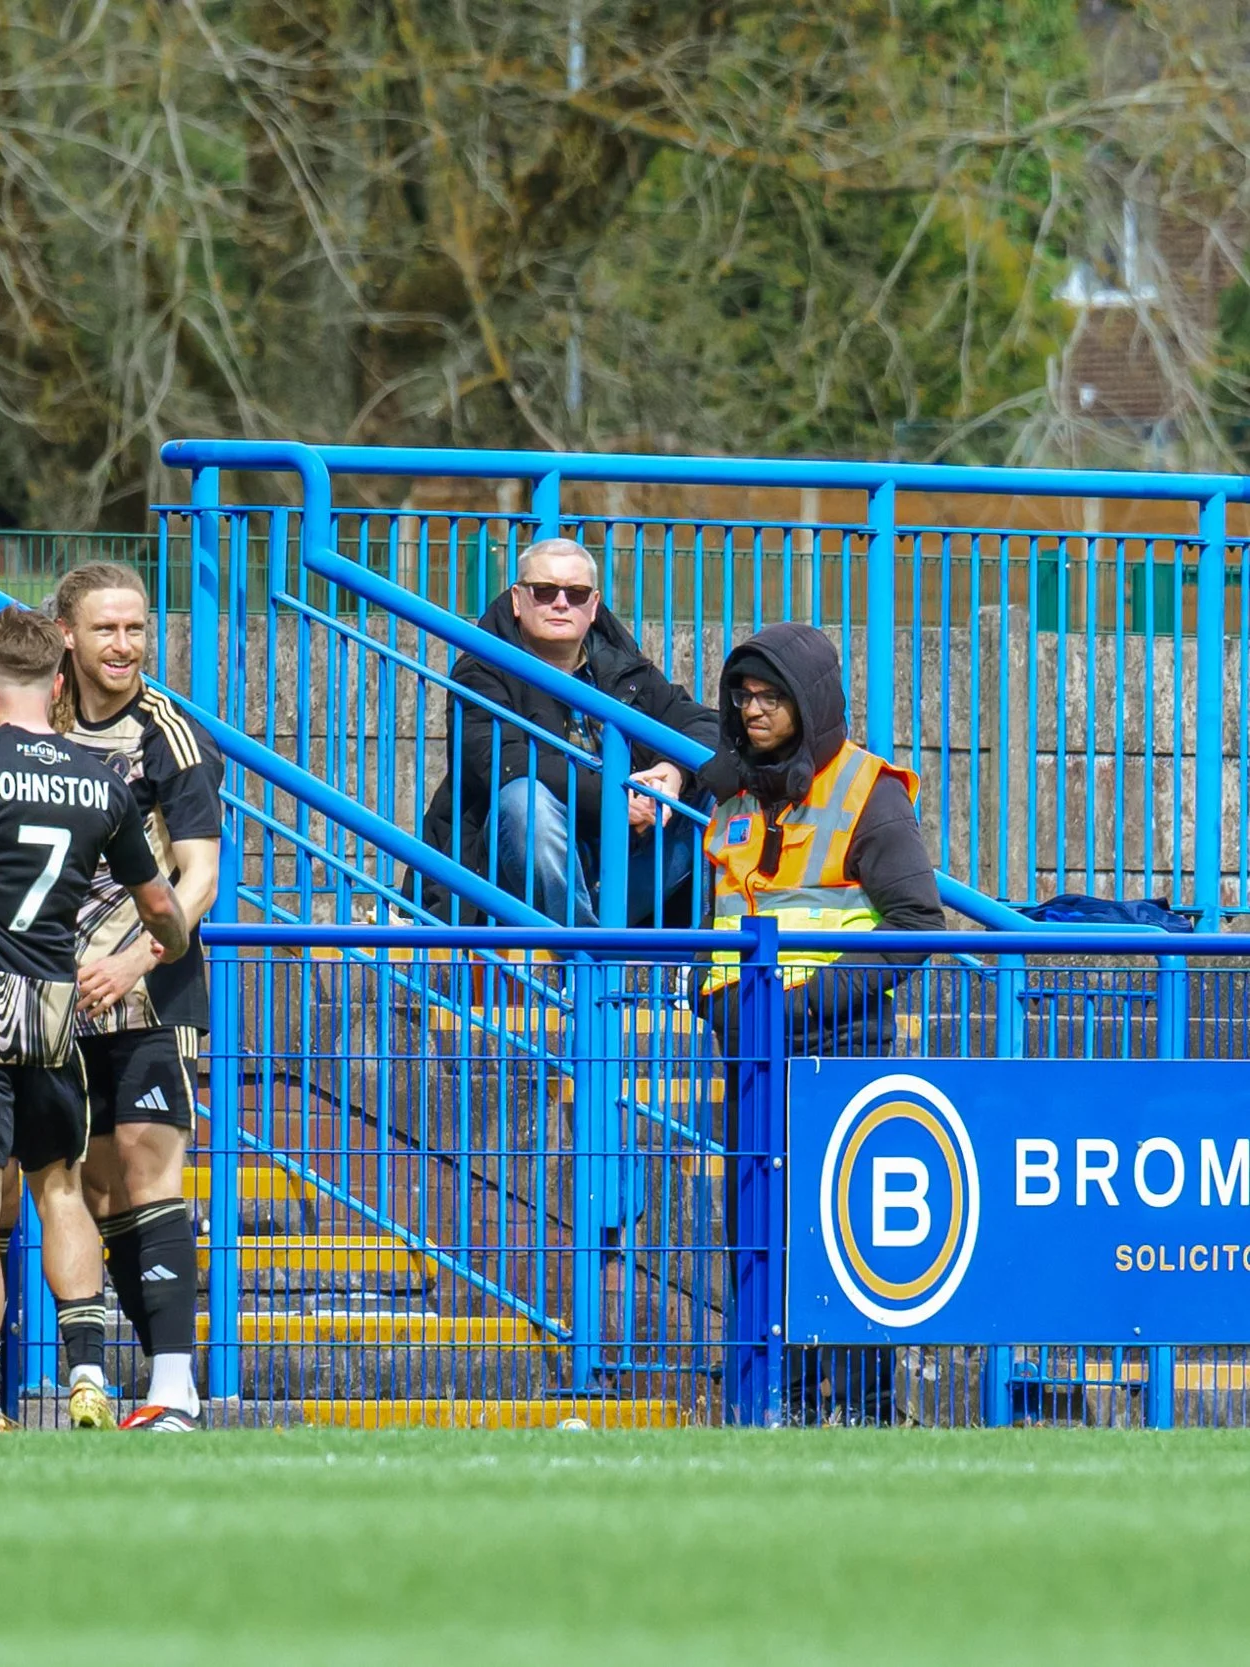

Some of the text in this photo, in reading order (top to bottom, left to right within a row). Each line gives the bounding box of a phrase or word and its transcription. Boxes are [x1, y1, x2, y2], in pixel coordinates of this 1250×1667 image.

[8, 825, 72, 932] 7
[872, 1157, 931, 1247] B
[1015, 1138, 1250, 1208] BROM
